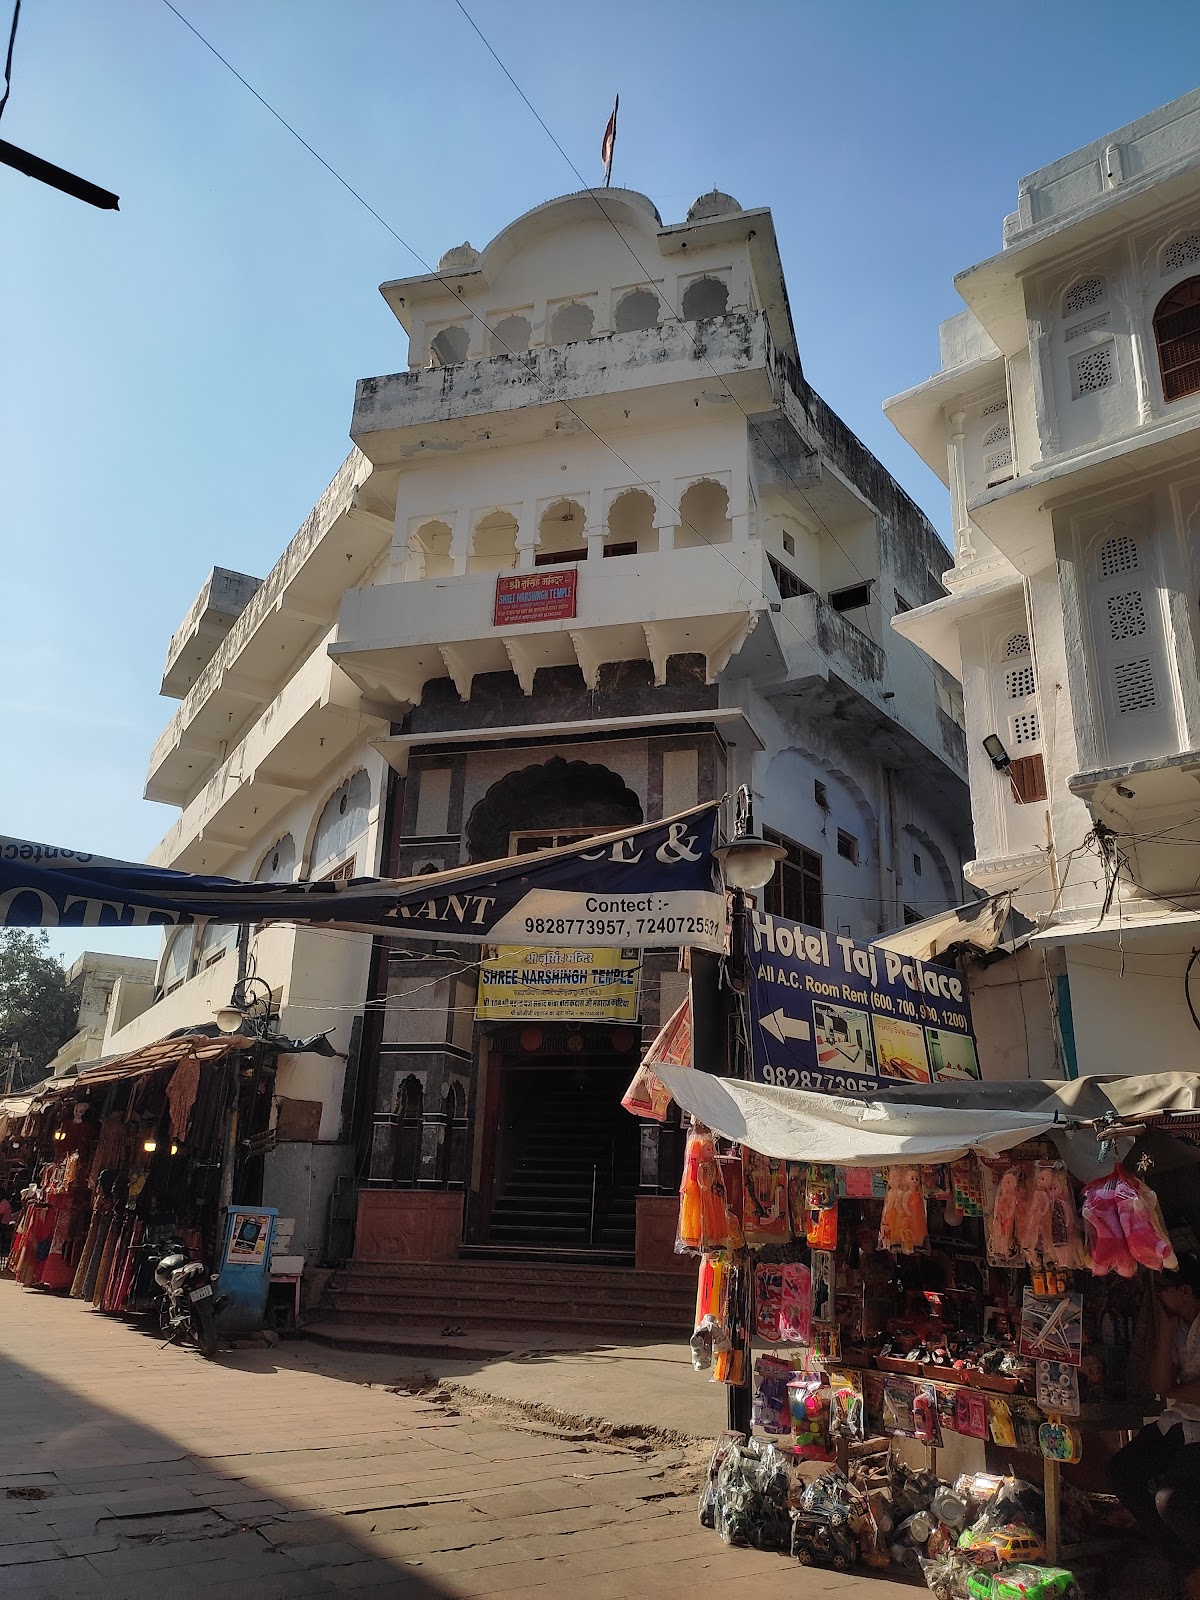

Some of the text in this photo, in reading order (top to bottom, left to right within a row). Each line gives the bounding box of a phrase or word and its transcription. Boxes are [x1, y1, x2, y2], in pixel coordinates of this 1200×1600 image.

[509, 578, 520, 590] श्री
[499, 593, 516, 604] SHREE
[550, 587, 571, 598] TEMPLE
[656, 823, 702, 864] &
[0, 844, 93, 863] ontec
[585, 896, 652, 914] Contect
[525, 916, 719, 938] 9828773957, 7240725531
[525, 952, 538, 964] श्री
[752, 910, 963, 1003] Hotel Taj Palace
[482, 969, 634, 985] SHREE NARSHINGH TEMPLE
[758, 963, 775, 983] All
[776, 969, 803, 989] A.C.
[805, 975, 840, 998] Room
[842, 987, 869, 1005] Rent
[870, 992, 896, 1015] (600,
[897, 998, 918, 1020] 700,
[941, 1010, 969, 1032] 1200)
